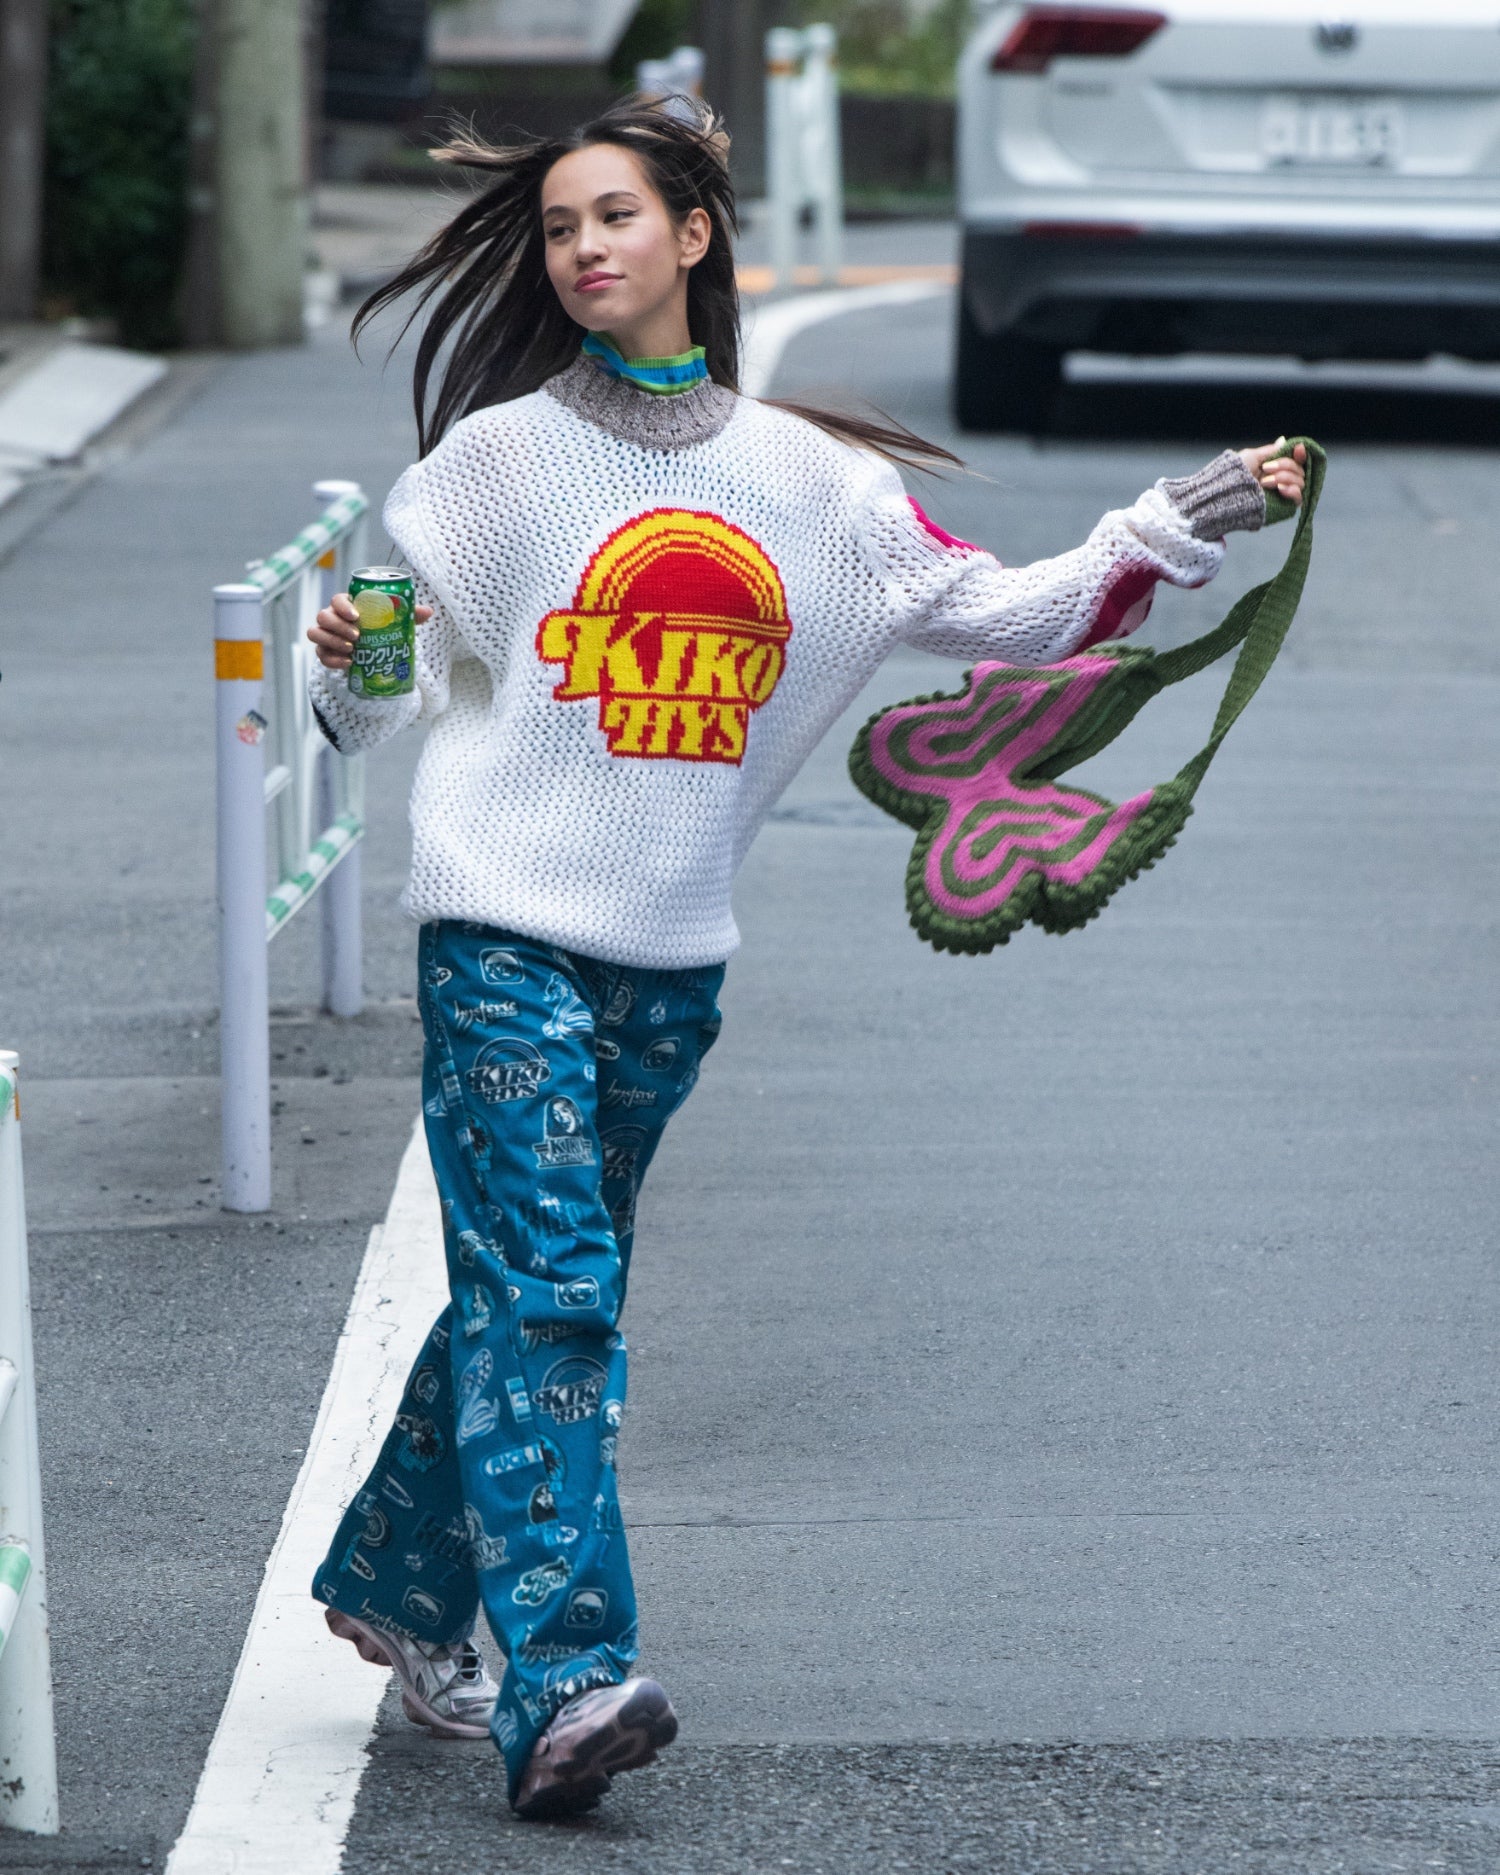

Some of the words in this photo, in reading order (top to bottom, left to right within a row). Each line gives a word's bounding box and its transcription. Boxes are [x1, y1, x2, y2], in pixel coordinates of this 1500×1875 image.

[364, 661, 395, 678] ソーダ
[541, 612, 782, 703] KIKO
